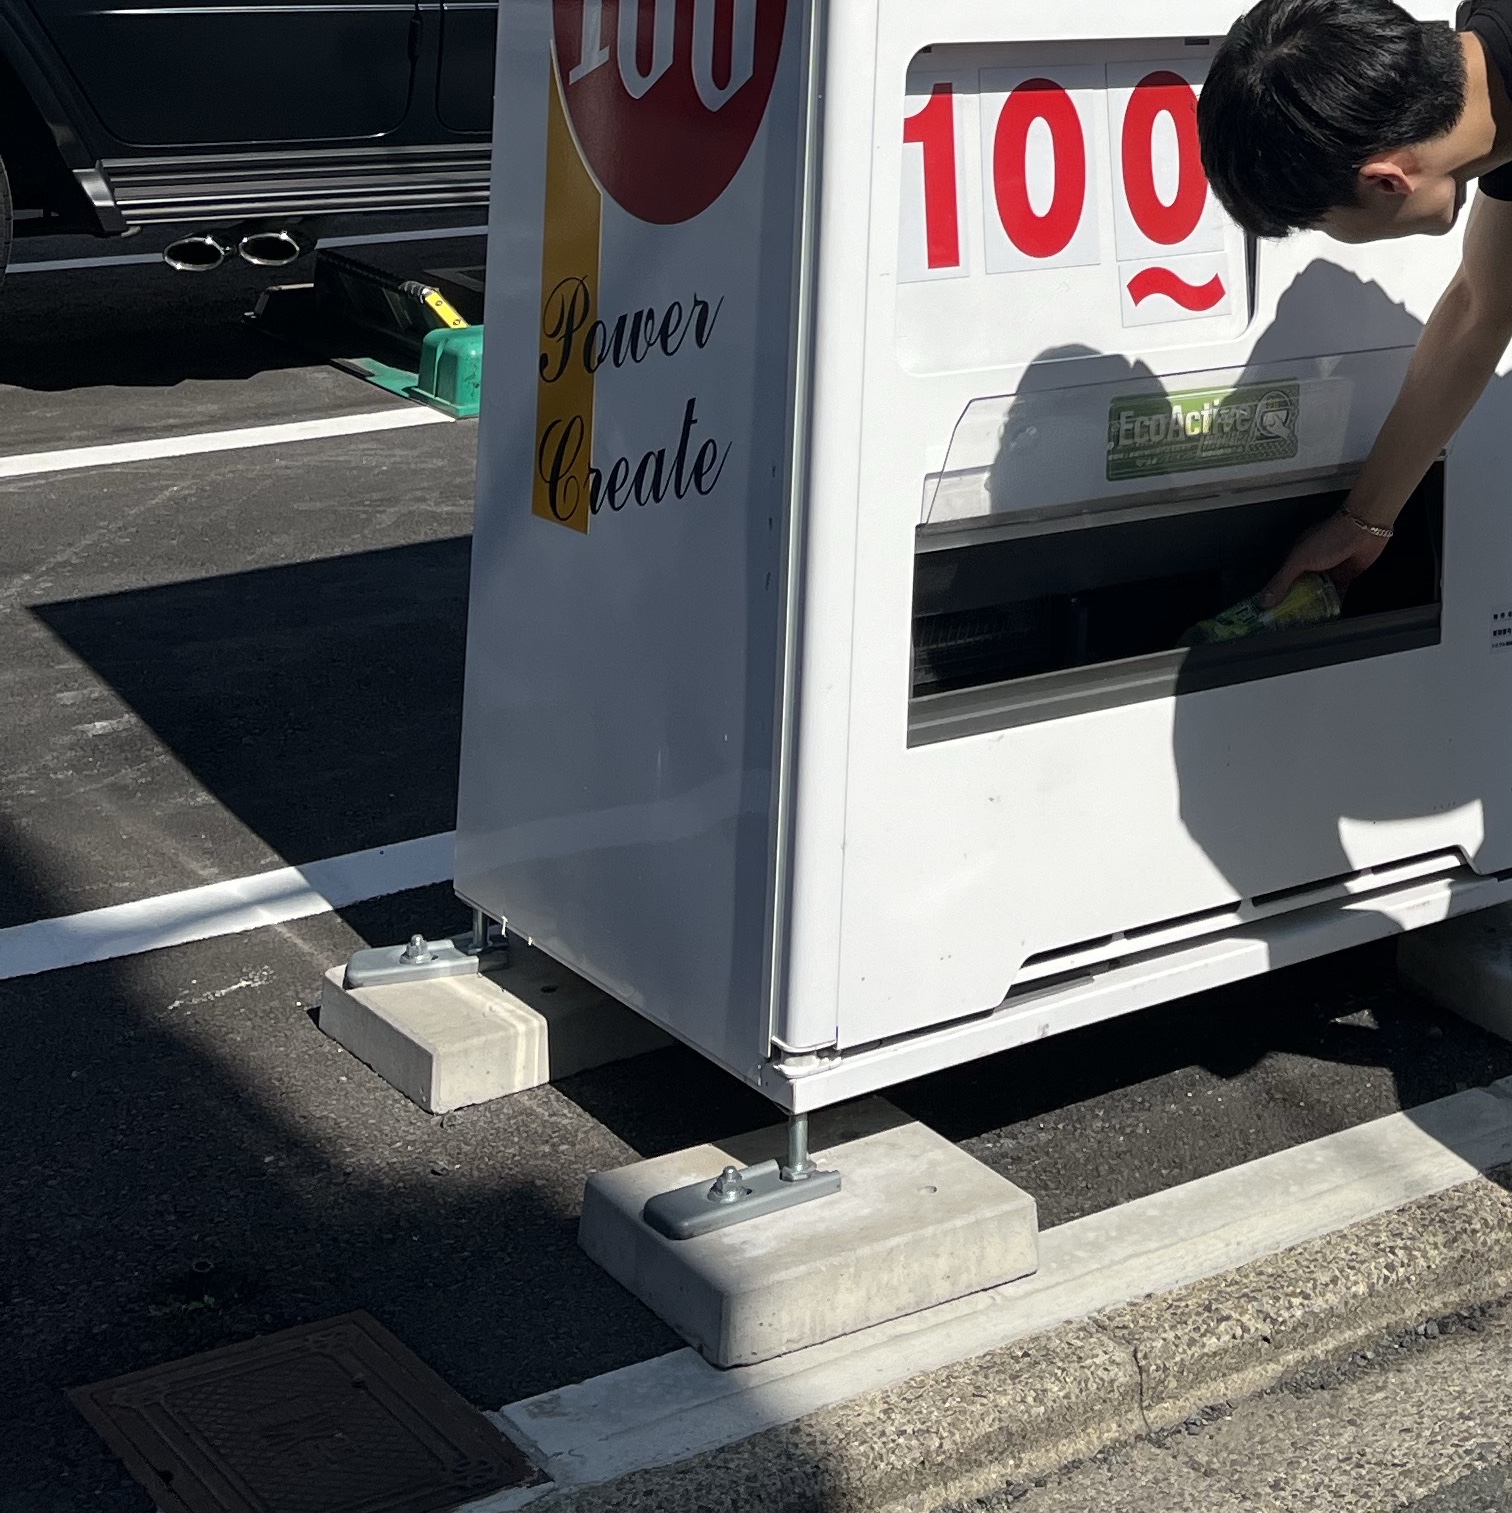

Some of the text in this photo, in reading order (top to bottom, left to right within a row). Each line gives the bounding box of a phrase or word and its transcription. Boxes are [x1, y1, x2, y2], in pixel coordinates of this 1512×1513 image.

[903, 69, 1209, 270] 100
[539, 274, 726, 384] Power
[539, 397, 733, 522] Create
